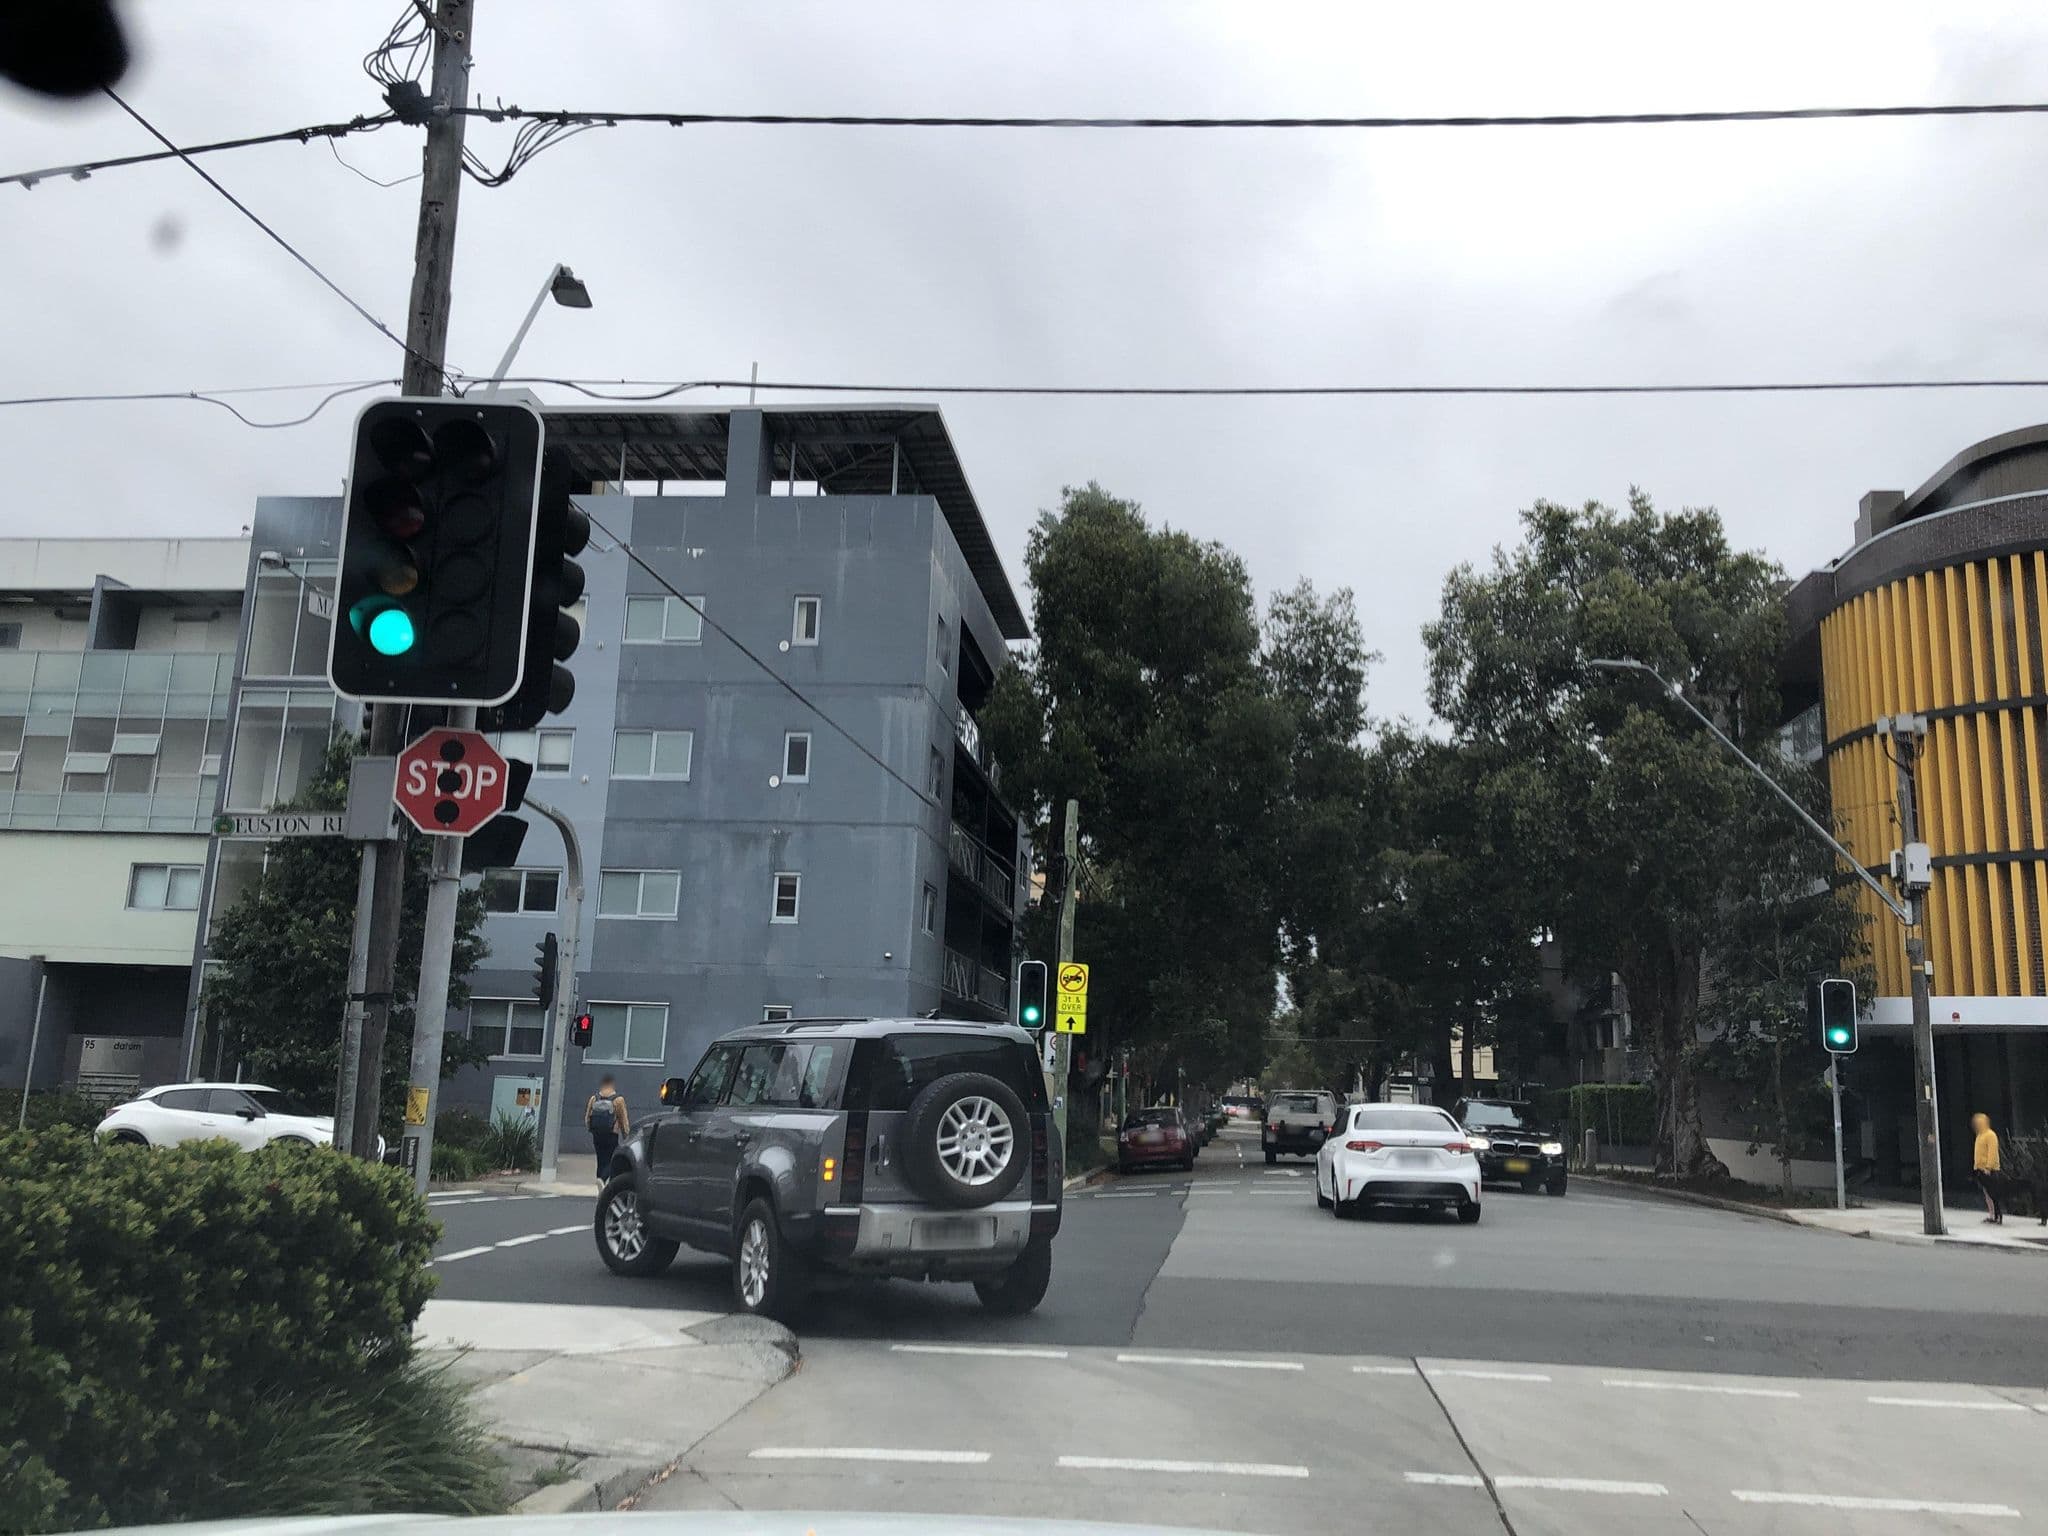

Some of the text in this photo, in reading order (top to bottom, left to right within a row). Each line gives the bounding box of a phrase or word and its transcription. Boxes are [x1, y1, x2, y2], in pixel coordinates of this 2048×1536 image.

[406, 758, 498, 801] STOP
[235, 815, 311, 834] EUSTON
[1061, 1003, 1082, 1011] OVER
[84, 1039, 141, 1051] 95 datum
